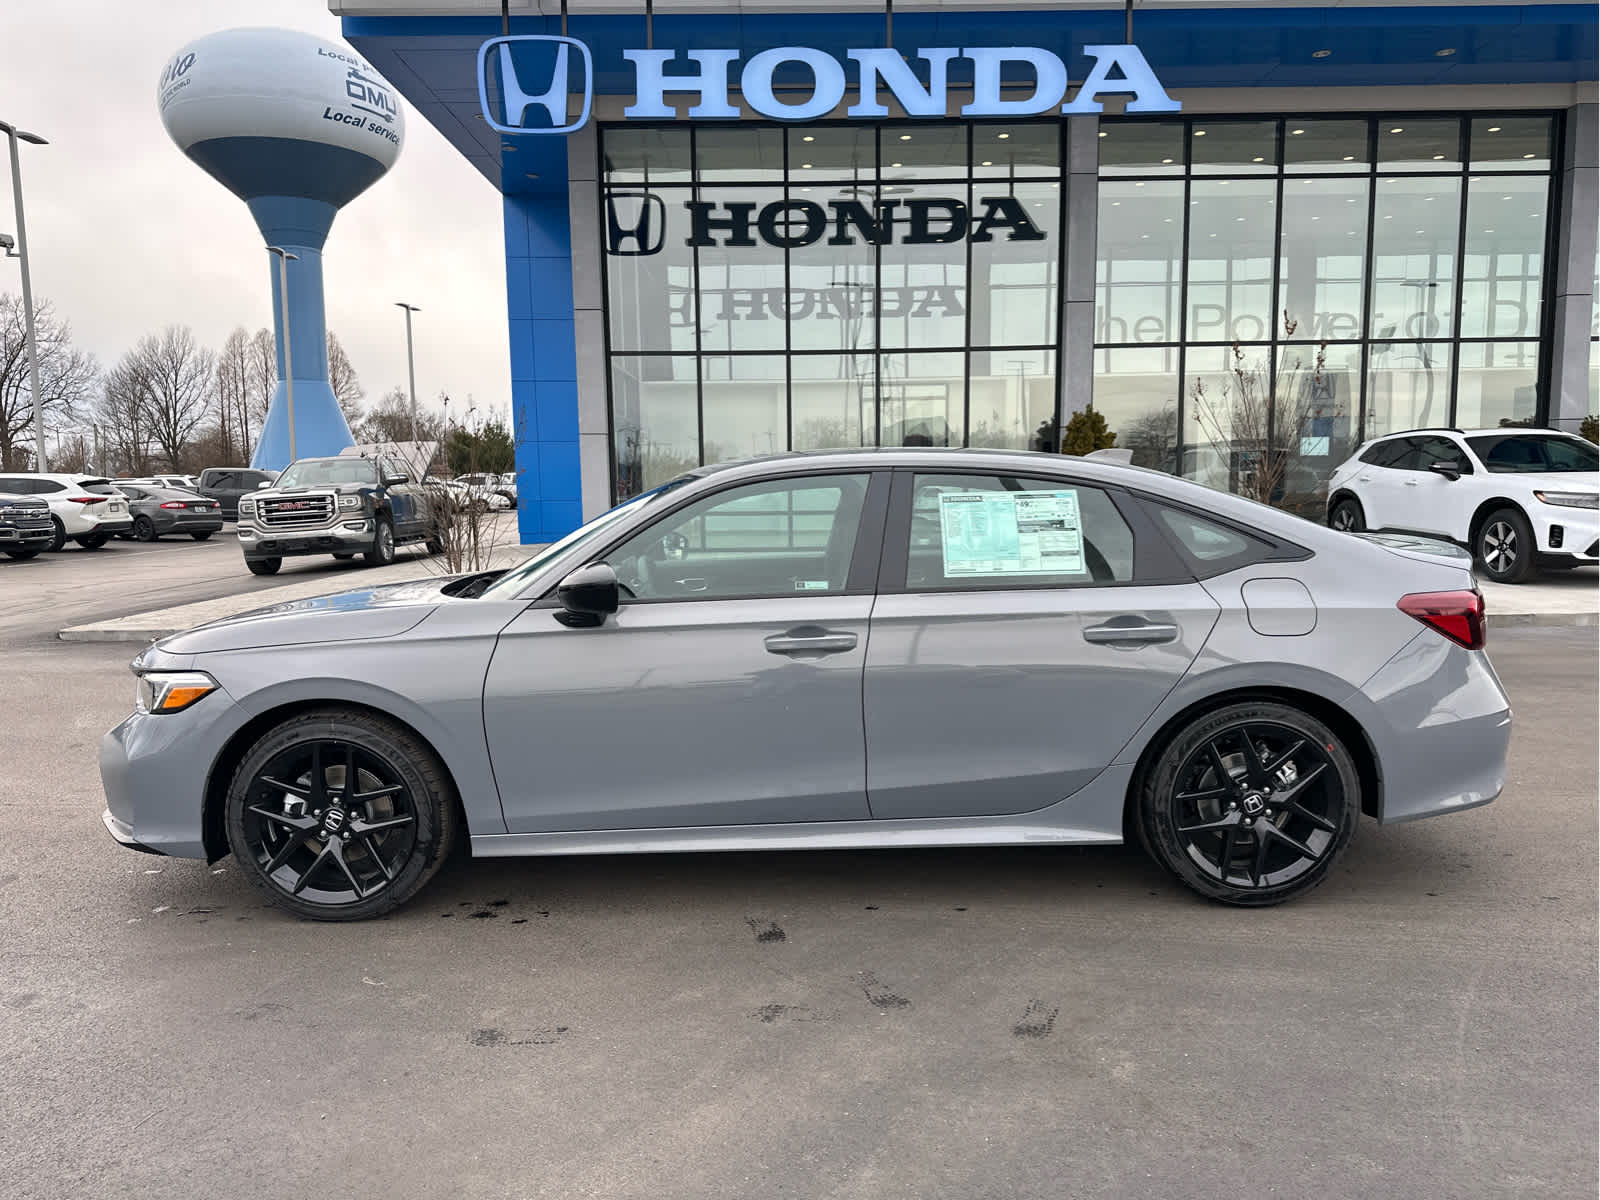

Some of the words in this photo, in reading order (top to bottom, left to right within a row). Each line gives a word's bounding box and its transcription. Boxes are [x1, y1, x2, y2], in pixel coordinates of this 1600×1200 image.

[622, 44, 1183, 120] HONDA
[322, 106, 367, 129] Local
[684, 196, 1047, 249] HONDA
[278, 500, 311, 511] GMC
